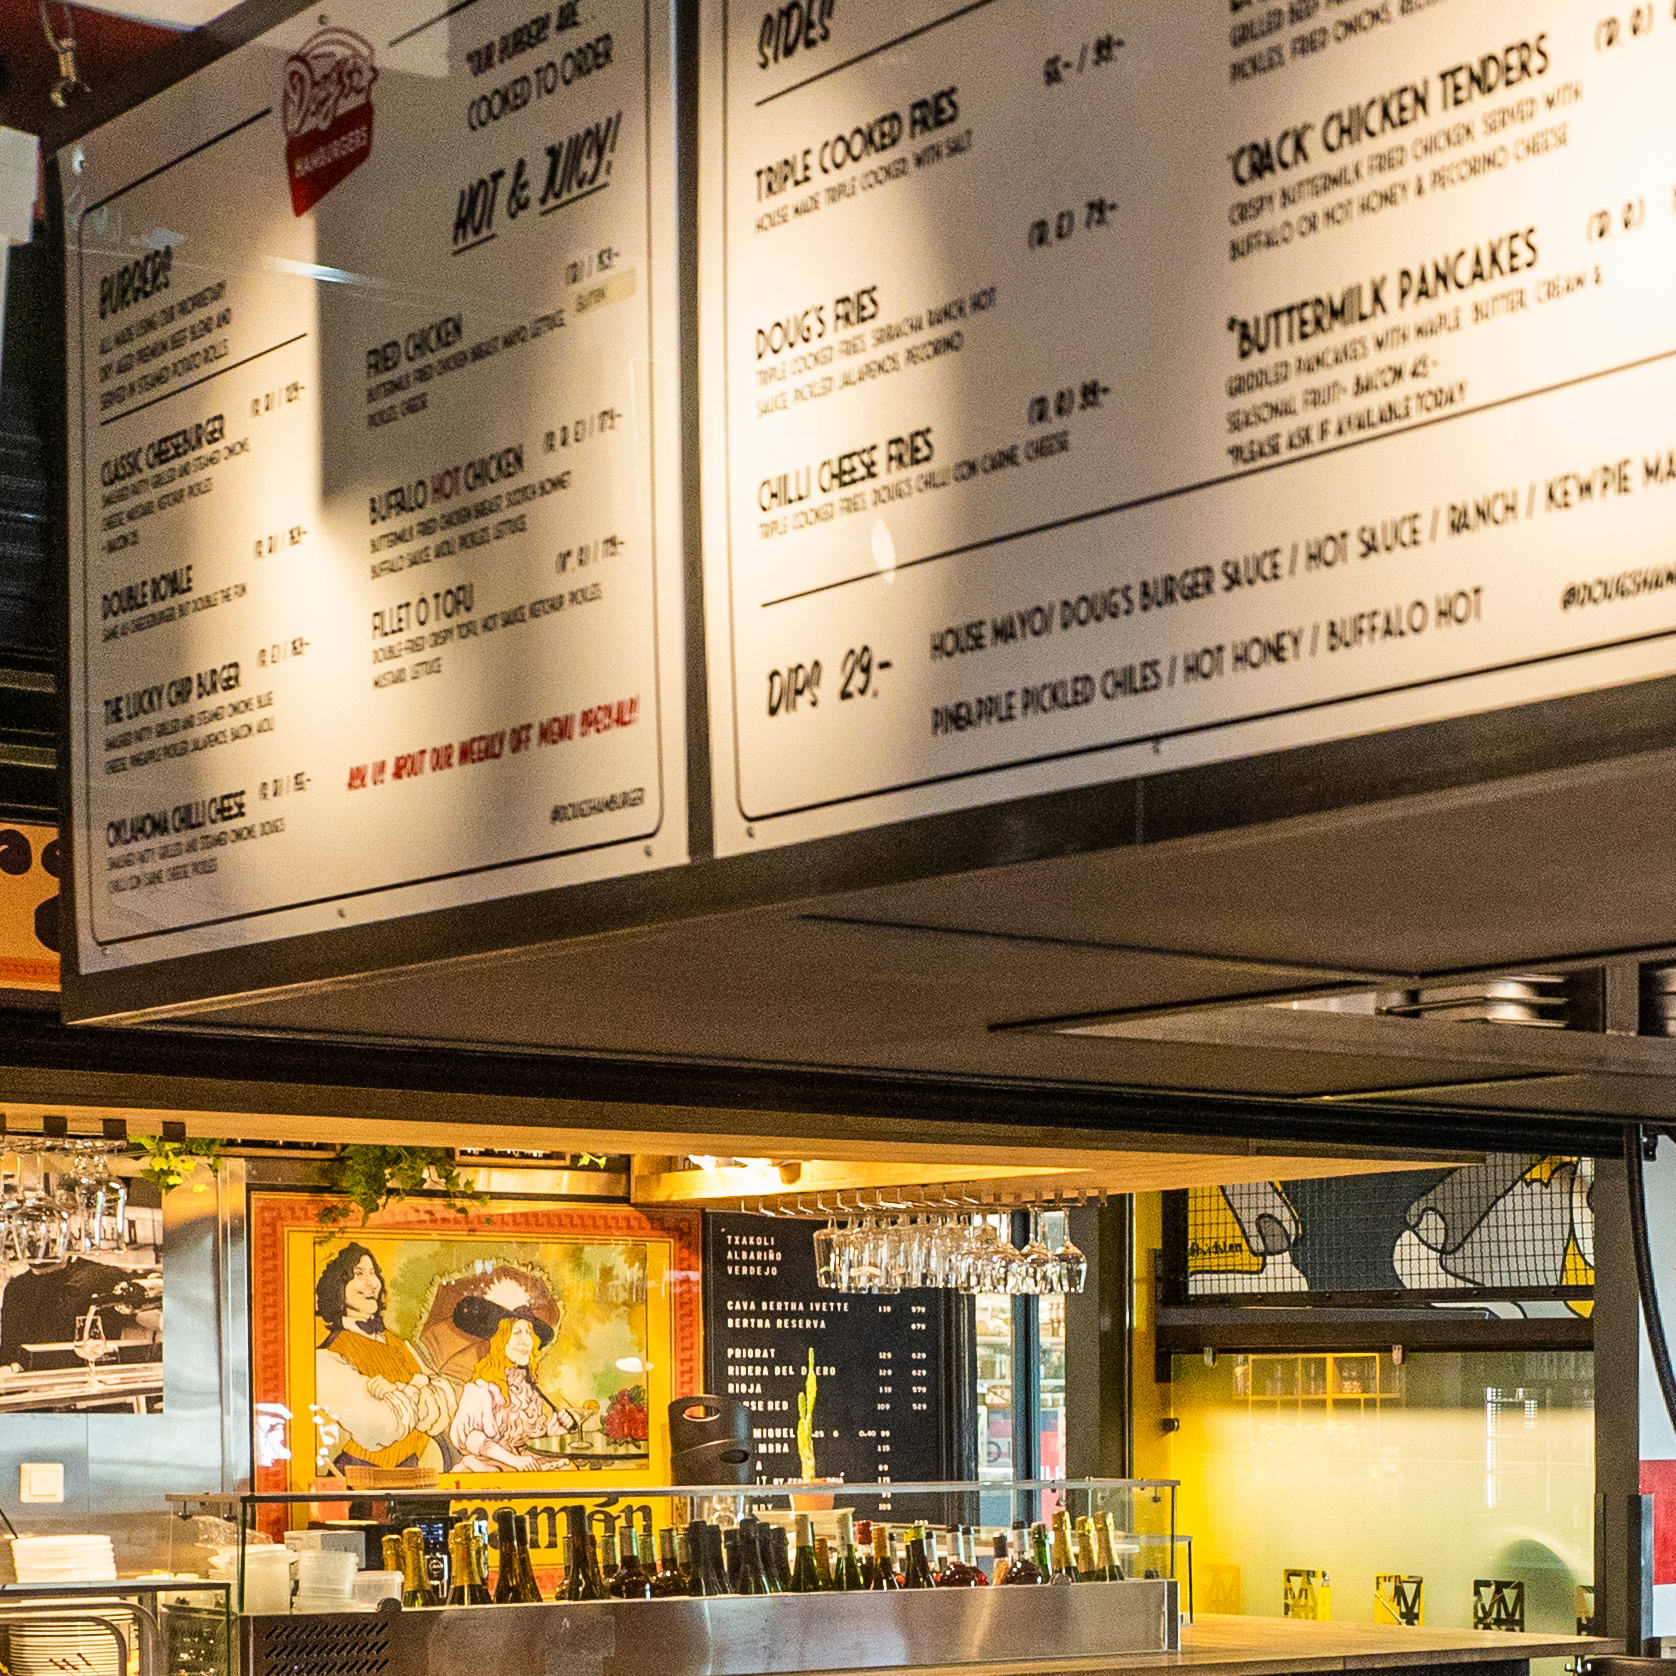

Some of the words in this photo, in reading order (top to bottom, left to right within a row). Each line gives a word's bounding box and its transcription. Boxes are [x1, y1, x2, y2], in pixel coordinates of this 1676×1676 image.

[468, 75, 532, 131] COOKED
[535, 61, 558, 98] TO
[561, 32, 613, 85] ORDER
[1321, 81, 1429, 154] CHICKEN
[1438, 32, 1551, 112] TENDERS
[755, 149, 813, 202] TRIPLE
[818, 111, 901, 174] COOKED
[908, 86, 960, 139] FRIES
[1367, 144, 1408, 178] FRIED
[1411, 120, 1476, 163] CHICKEN
[1482, 98, 1538, 138] SERVED
[1544, 81, 1583, 111] WITH
[454, 169, 504, 244] HOT
[539, 111, 623, 205] JUICY!
[1227, 226, 1295, 262] BUFFALO
[1298, 217, 1321, 241] OR
[1323, 201, 1355, 232] HOT
[1358, 181, 1409, 219] HONEY
[1429, 146, 1510, 192] PECORINO
[1513, 121, 1570, 162] CHEESE
[1399, 227, 1538, 312] PANCAKES
[755, 304, 827, 361] DOUG'S
[834, 285, 880, 335] FRIES
[968, 286, 997, 315] HOT
[404, 313, 463, 362] CHICKEN
[1295, 338, 1370, 382] PANCAKES
[1374, 325, 1411, 356] WITH
[1414, 306, 1463, 344] MAPLE
[1472, 288, 1527, 326] BUTTER
[1535, 270, 1587, 306] CREAM
[1226, 397, 1298, 434] SEASONAL
[1352, 364, 1408, 396] BACON
[1286, 422, 1314, 452] ASK
[1318, 415, 1331, 444] IF
[1414, 380, 1469, 418] TODAY
[145, 414, 224, 470] CHEESEBURGER
[1025, 429, 1070, 464] CHEESE
[464, 444, 525, 492] CHICKEN
[759, 465, 812, 514] CHILLI
[818, 444, 880, 495] CHEESE
[886, 426, 934, 476] FRIES
[930, 618, 987, 662] HOUSE
[1060, 584, 1134, 631] DOUG'S
[1139, 564, 1215, 610] BURGER
[1223, 548, 1282, 588] SAUCE
[1305, 531, 1351, 571] HOT
[1356, 513, 1423, 560] SAUCE
[1448, 486, 1520, 536] RANCH
[1545, 458, 1632, 514] KEWPIE
[433, 583, 474, 621] TOFU
[196, 662, 241, 699] BURGER
[930, 688, 1017, 737] PINEAPPLE
[1020, 673, 1097, 719] PICKLED
[1099, 657, 1162, 700] CHILES
[1183, 645, 1224, 682] HOT
[1230, 627, 1302, 672] HONEY
[1327, 601, 1429, 653] BUFFALO
[1434, 584, 1485, 629] HOT
[766, 658, 822, 717] DIPS
[207, 790, 246, 824] CHEESE
[727, 1235, 775, 1246] TXAKOLI
[727, 1250, 782, 1261] ALBARIÑO
[727, 1266, 777, 1276] VERDEJO
[727, 1301, 756, 1311] CAVA
[762, 1302, 804, 1312] BERTHA
[810, 1302, 849, 1312] IVETTE
[728, 1319, 771, 1329] BERTHA
[777, 1320, 826, 1329] RESERVA
[728, 1349, 776, 1359] PRIORAT
[728, 1366, 771, 1376] RIBERA
[775, 1366, 795, 1376] DEL
[728, 1384, 762, 1393] RIOJA
[768, 1401, 789, 1411] RED
[753, 1428, 795, 1438] MIGUEL
